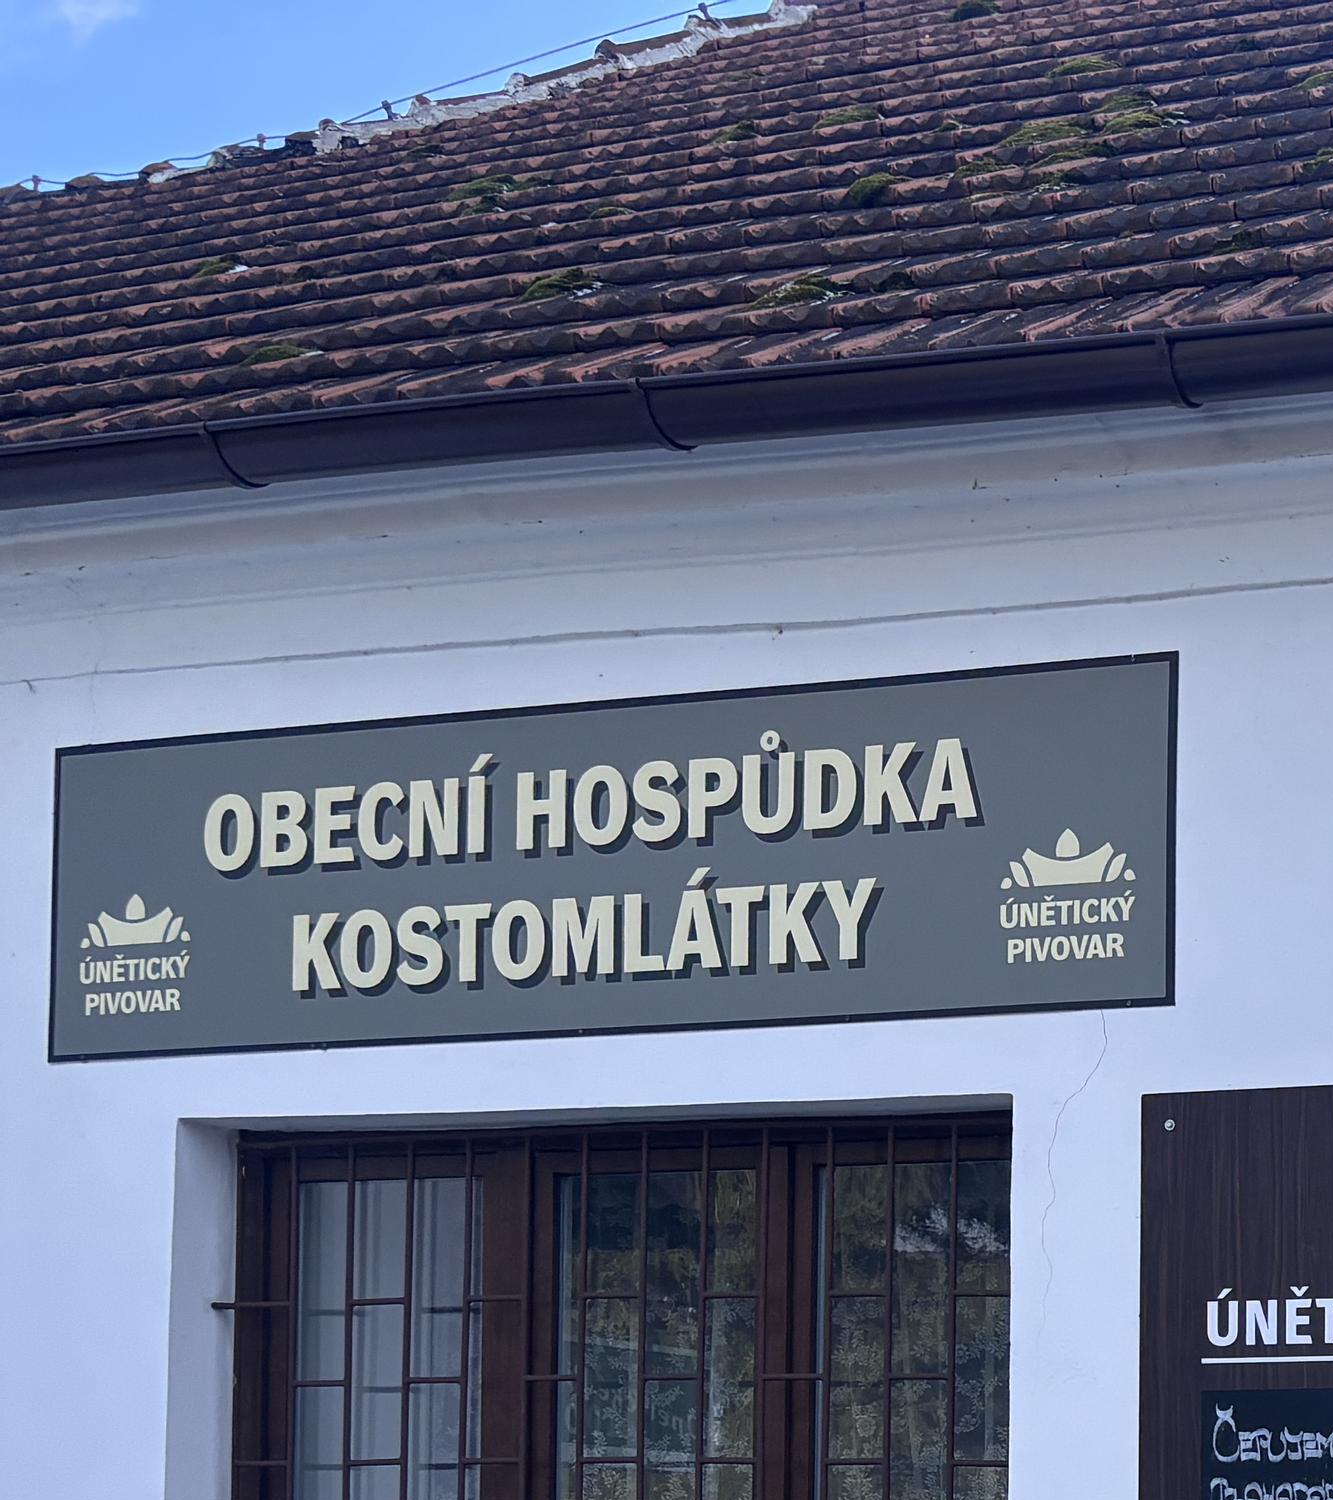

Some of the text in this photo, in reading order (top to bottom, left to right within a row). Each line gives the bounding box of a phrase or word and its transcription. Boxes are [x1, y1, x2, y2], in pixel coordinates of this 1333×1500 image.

[203, 731, 980, 877] OBECNÍ HOSPŮDKA
[1000, 890, 1136, 929] ÚNĚTICKÝ
[291, 869, 879, 995] KOSTOMLÁTKY
[1007, 933, 1125, 964] PIVOVAR
[80, 949, 190, 985] ÚNĚTICKÝ
[85, 988, 181, 1016] PIVOVAR
